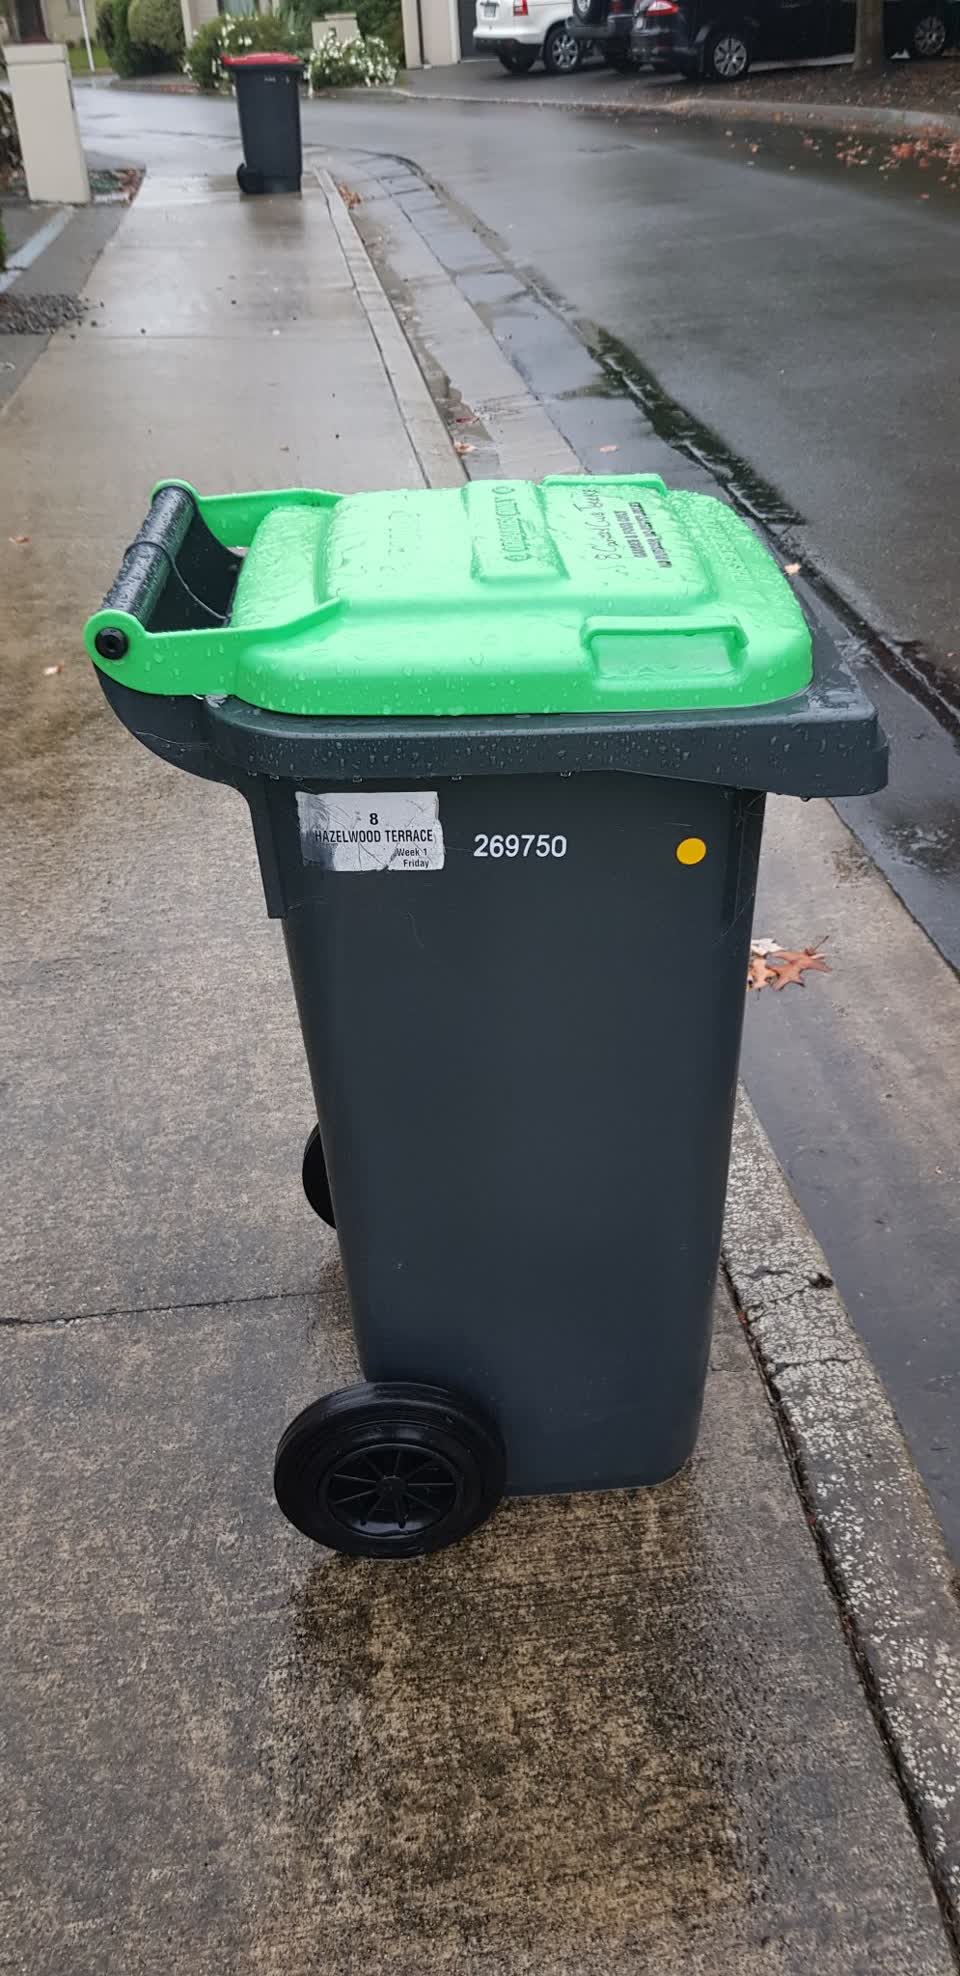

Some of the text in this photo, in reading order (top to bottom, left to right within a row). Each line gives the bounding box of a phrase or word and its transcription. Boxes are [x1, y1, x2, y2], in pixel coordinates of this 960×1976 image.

[369, 812, 379, 826] 8
[314, 829, 433, 843] HAZELWOOD TERRACE
[396, 847, 428, 857] Week 1
[473, 834, 567, 858] 269750
[403, 859, 430, 869] Friday
